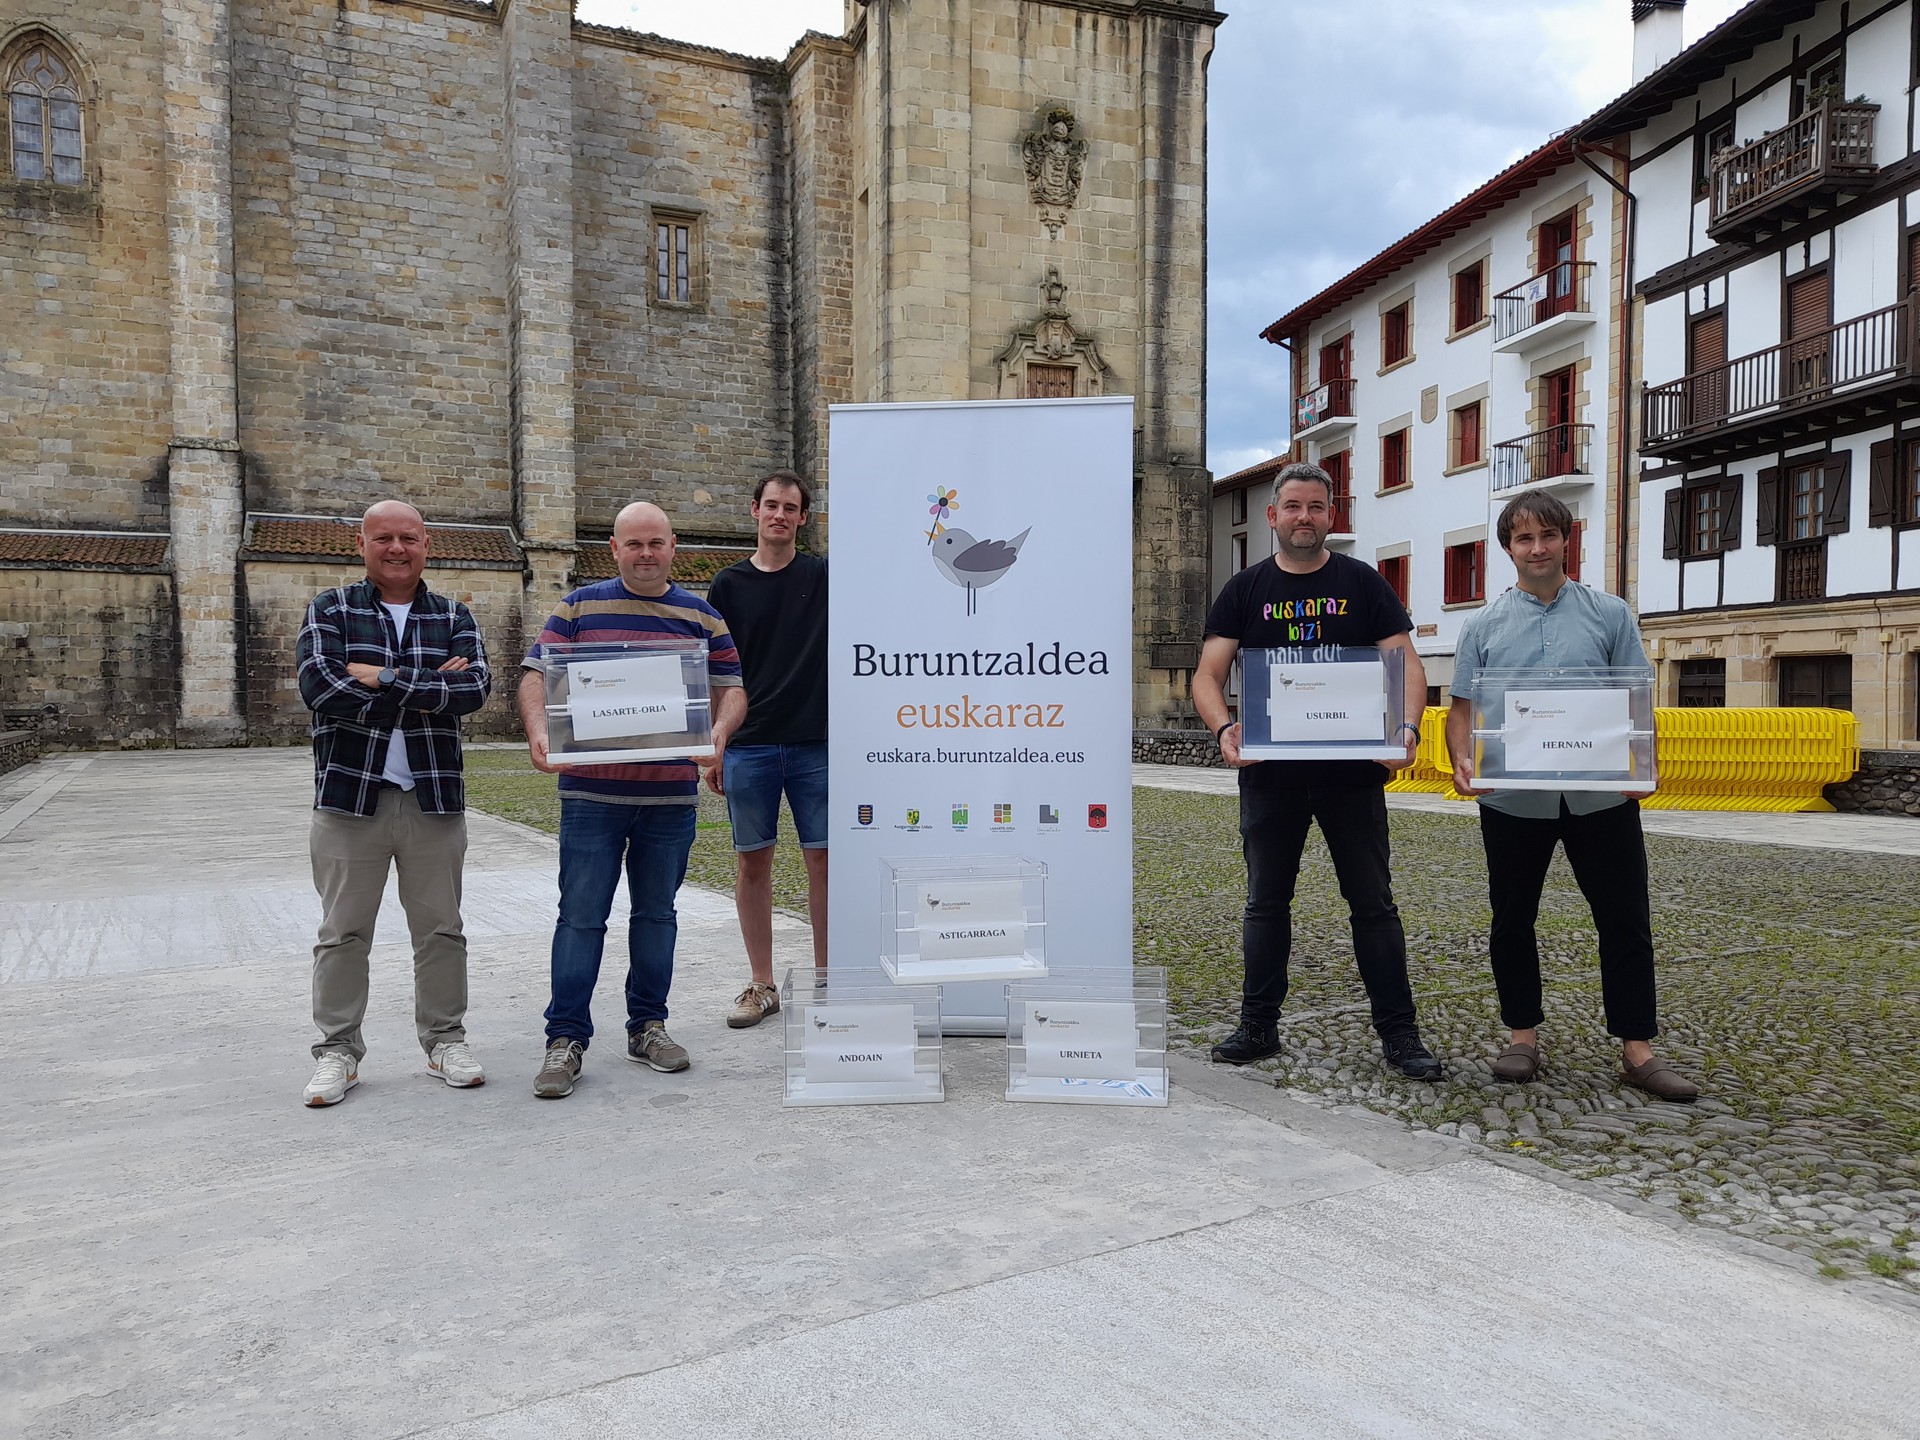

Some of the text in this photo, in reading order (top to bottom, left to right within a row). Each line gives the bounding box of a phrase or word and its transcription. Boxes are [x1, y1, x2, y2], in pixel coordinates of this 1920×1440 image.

[1263, 597, 1348, 621] euskaraz
[1288, 620, 1322, 641] bizi
[852, 641, 1110, 677] Buruntzaldea
[1265, 642, 1343, 667] nahi dut
[592, 704, 667, 718] LASARTE-ORIA
[896, 694, 1065, 728] euskaraz
[1306, 712, 1349, 720] USURBIL
[1542, 741, 1593, 749] HERNANI
[866, 748, 1085, 763] euskara.buruntzaldea.eus
[938, 929, 1006, 940] ASTIGARRAGA
[837, 1053, 883, 1063] ANDOAIN
[1059, 1050, 1102, 1059] URNIETA
